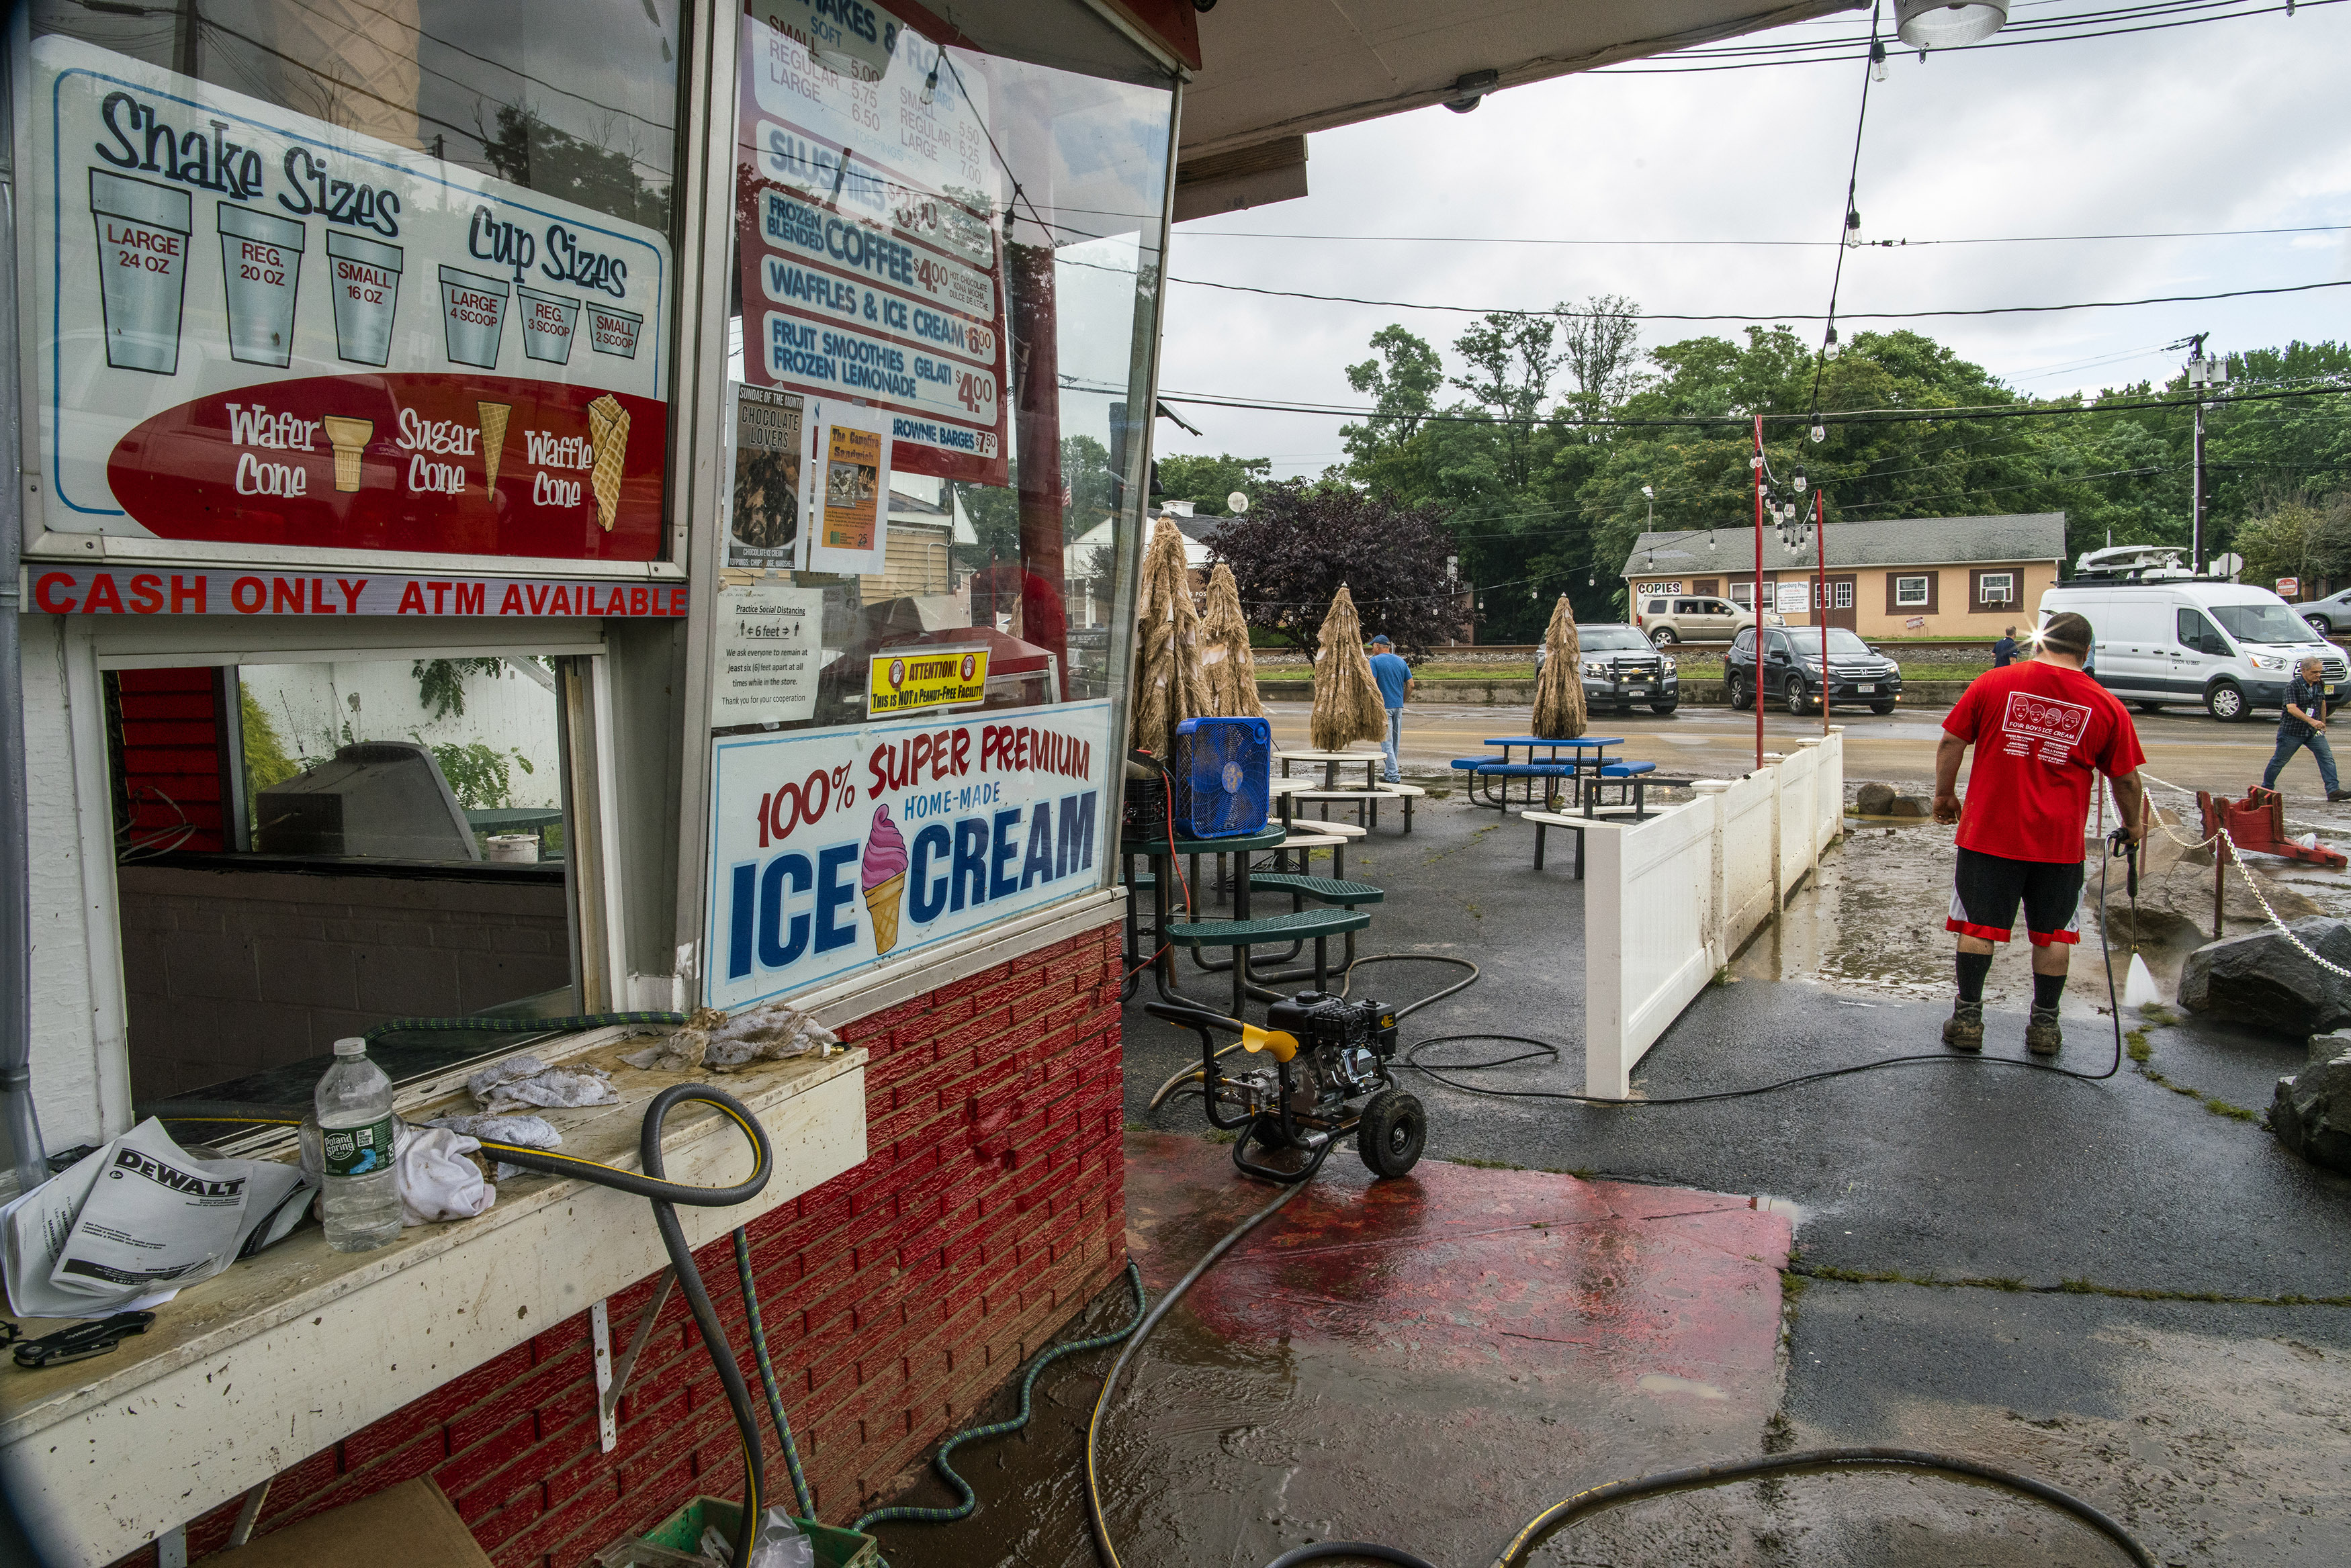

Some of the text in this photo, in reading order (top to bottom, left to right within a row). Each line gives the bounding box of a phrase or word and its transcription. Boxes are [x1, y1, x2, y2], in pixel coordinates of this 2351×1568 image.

[811, 16, 842, 48] SOFT
[769, 15, 879, 88] SMALL 5.00
[769, 38, 878, 109] REGULAR 5.75
[770, 62, 880, 132] LARGE 6.50
[900, 86, 979, 146] SMALL 5.50
[854, 128, 903, 162] TOPPINGS
[901, 107, 979, 165] REGULAR 6.25
[95, 91, 401, 238] Shake Sizes
[901, 128, 981, 185] LARGE 7.00
[769, 129, 886, 212] SLUSHIES
[769, 195, 822, 233] FROZEN
[107, 224, 179, 257] LARGE
[767, 218, 825, 253] BLENDED
[120, 251, 170, 275] 24 OZ
[242, 242, 284, 267] REG.
[470, 204, 627, 298] Cup Sizes
[825, 218, 914, 287] COFFEE
[240, 265, 285, 287] 20 OZ
[338, 262, 392, 289] SMALL
[949, 271, 987, 293] HOT CHOCOLATE
[347, 285, 383, 304] 16 OZ
[451, 289, 498, 314] LARGE
[949, 289, 989, 312] DULCE DE LECHE
[953, 281, 985, 301] KONA MOCHA
[536, 303, 564, 323] REG.
[770, 261, 856, 315] WAFFLES
[863, 292, 878, 322] &
[883, 300, 907, 332] ICE
[913, 309, 965, 349] CREAM
[450, 308, 498, 328] 4 SCOOP
[528, 318, 570, 337] 3 SCOOP
[596, 315, 634, 337] SMALL
[596, 332, 633, 349] 2 SCOOP
[772, 318, 817, 352] FRUIT
[823, 331, 904, 373] SMOOTHIES
[914, 357, 952, 386] GELATI
[773, 347, 916, 400] FROZEN LEMONADE
[740, 387, 803, 410] SUNDAE OF THE MONTH
[226, 403, 320, 452] Wafer
[742, 406, 799, 431] CHOCOLATE
[396, 408, 480, 457] Sugar
[750, 426, 789, 449] LOVERS
[832, 428, 879, 451] The Campfire
[940, 428, 974, 449] BARGES
[525, 430, 592, 469] Waffle
[834, 446, 874, 463] Sandwich
[236, 453, 306, 498] Cone
[408, 455, 465, 494] Cone
[533, 471, 580, 508] Cone
[729, 558, 795, 568] TOPPINGS: HARDSHELL
[743, 548, 766, 557] CHOCOLATE
[772, 549, 783, 557] CREAM
[35, 571, 686, 616] CASH ONLY ATM AVAILABLE
[1638, 583, 1679, 594] COPIES
[1777, 582, 1797, 590] Jamesburg
[736, 604, 805, 616] Practice Social Distancing
[756, 625, 780, 637] 6 feet
[726, 649, 736, 657] We
[737, 648, 747, 657] ask
[747, 650, 772, 658] everyone
[801, 648, 808, 656] at
[729, 663, 743, 672] least
[744, 663, 752, 672] six
[752, 663, 760, 673] (6)
[772, 663, 788, 673] apart
[909, 660, 957, 681] ATTENTION!
[732, 679, 748, 687] times
[748, 678, 763, 686] while
[781, 678, 798, 686] store.
[722, 694, 805, 706] Thank you for your cooperation
[898, 690, 914, 706] NOT
[914, 692, 918, 703] A
[2025, 724, 2042, 732] BOYS
[2042, 727, 2053, 735] ICE
[2053, 731, 2075, 740] CREAM
[2042, 747, 2067, 755] MILLTOWN
[2043, 741, 2070, 749] JAMESBURG
[758, 725, 1090, 848] 100% SUPER PREMIUM
[905, 781, 1000, 821] HOME-MADE
[729, 790, 1097, 979] ICE CREAM
[324, 1133, 353, 1147] Poland
[326, 1142, 355, 1156] Spring
[42, 1224, 50, 1250] VOULOIR
[48, 1219, 58, 1248] MANUEL
[94, 1224, 115, 1233] Pressure
[116, 1230, 132, 1238] Washer
